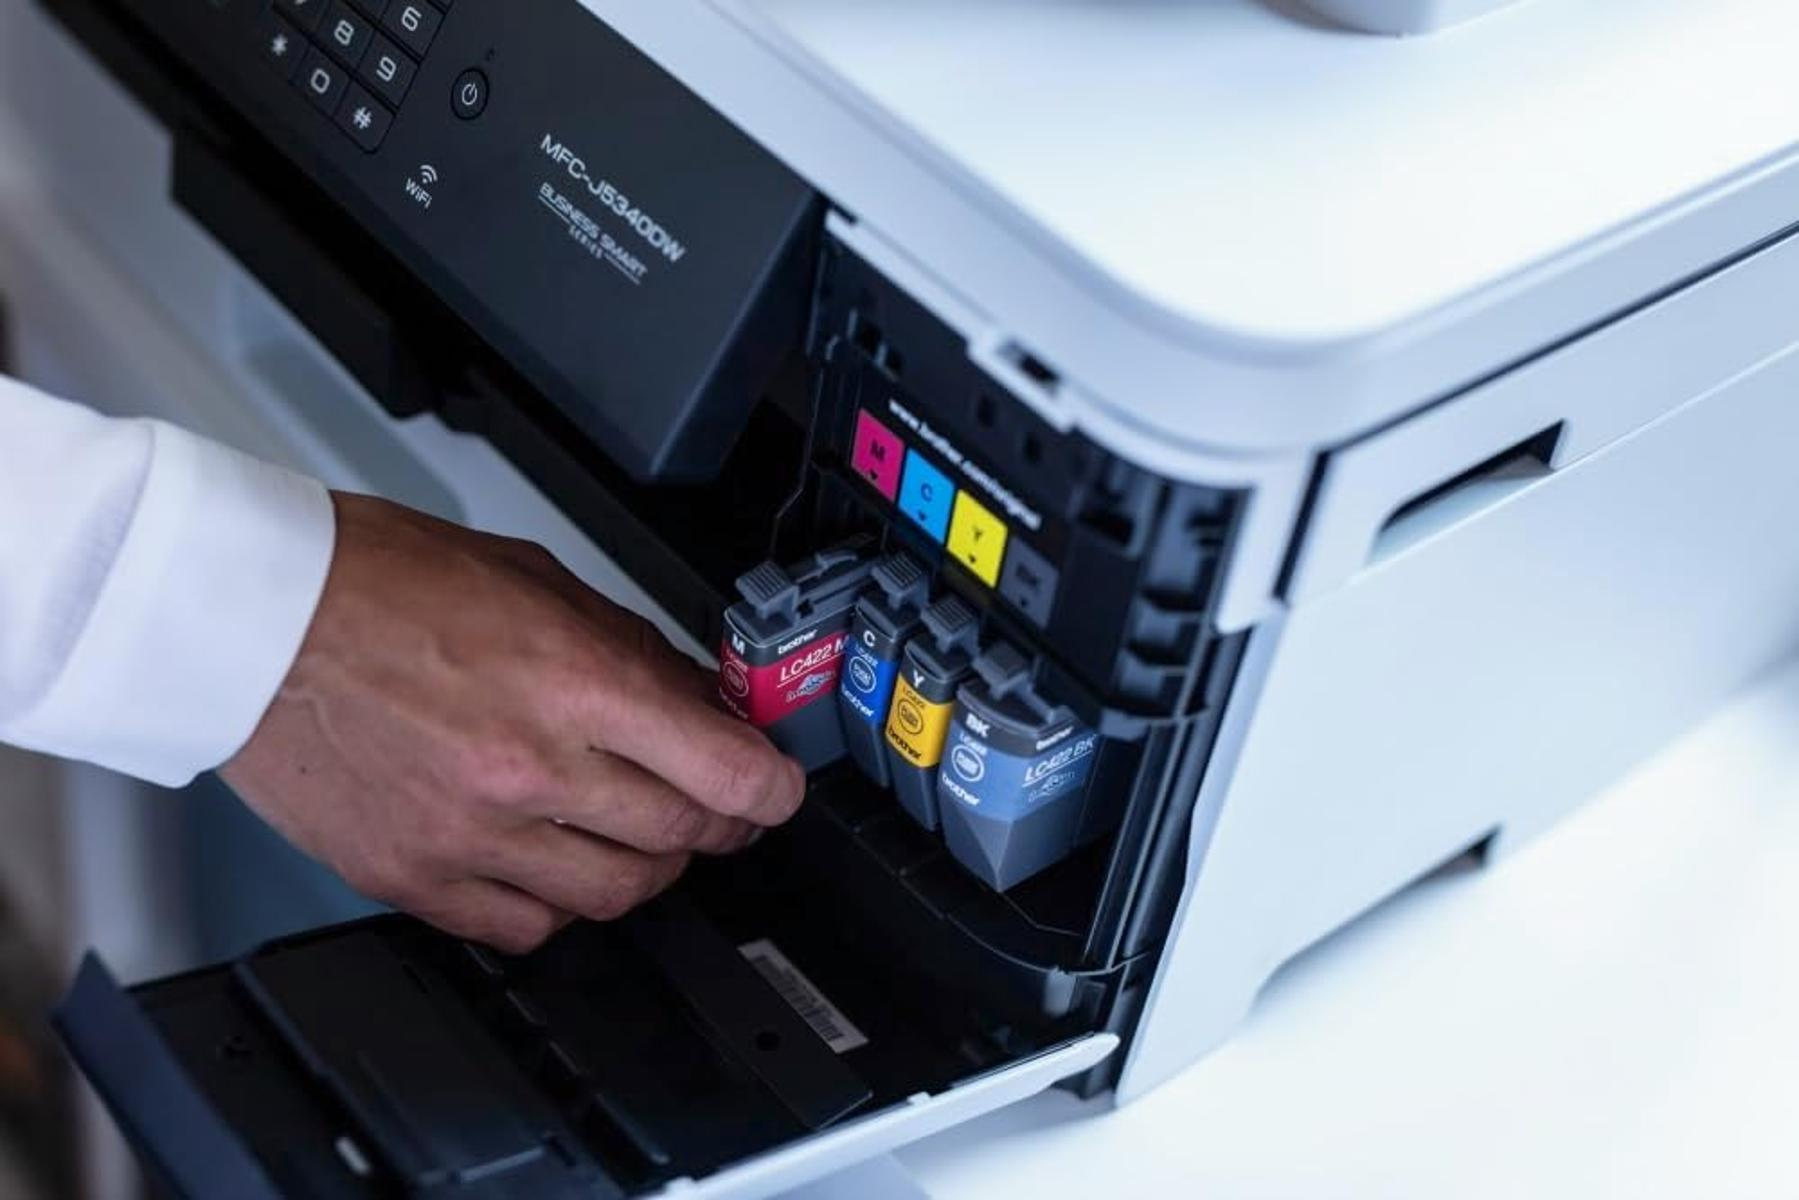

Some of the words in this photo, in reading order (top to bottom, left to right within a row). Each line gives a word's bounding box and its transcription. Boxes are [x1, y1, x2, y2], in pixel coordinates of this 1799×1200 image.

[402, 6, 422, 31] 6
[334, 20, 354, 45] 8
[376, 56, 396, 81] 9
[353, 107, 372, 129] #
[540, 133, 685, 262] MFC-J5340DW
[539, 182, 600, 239] BUSINESS
[600, 233, 648, 276] SMART
[870, 442, 885, 461] M
[920, 483, 934, 502] C
[972, 525, 983, 541] Y
[732, 634, 746, 655] M
[863, 630, 876, 648] C
[780, 643, 832, 681] LC422
[912, 670, 925, 688] Y
[965, 713, 991, 738] BK
[941, 772, 981, 806] brother
